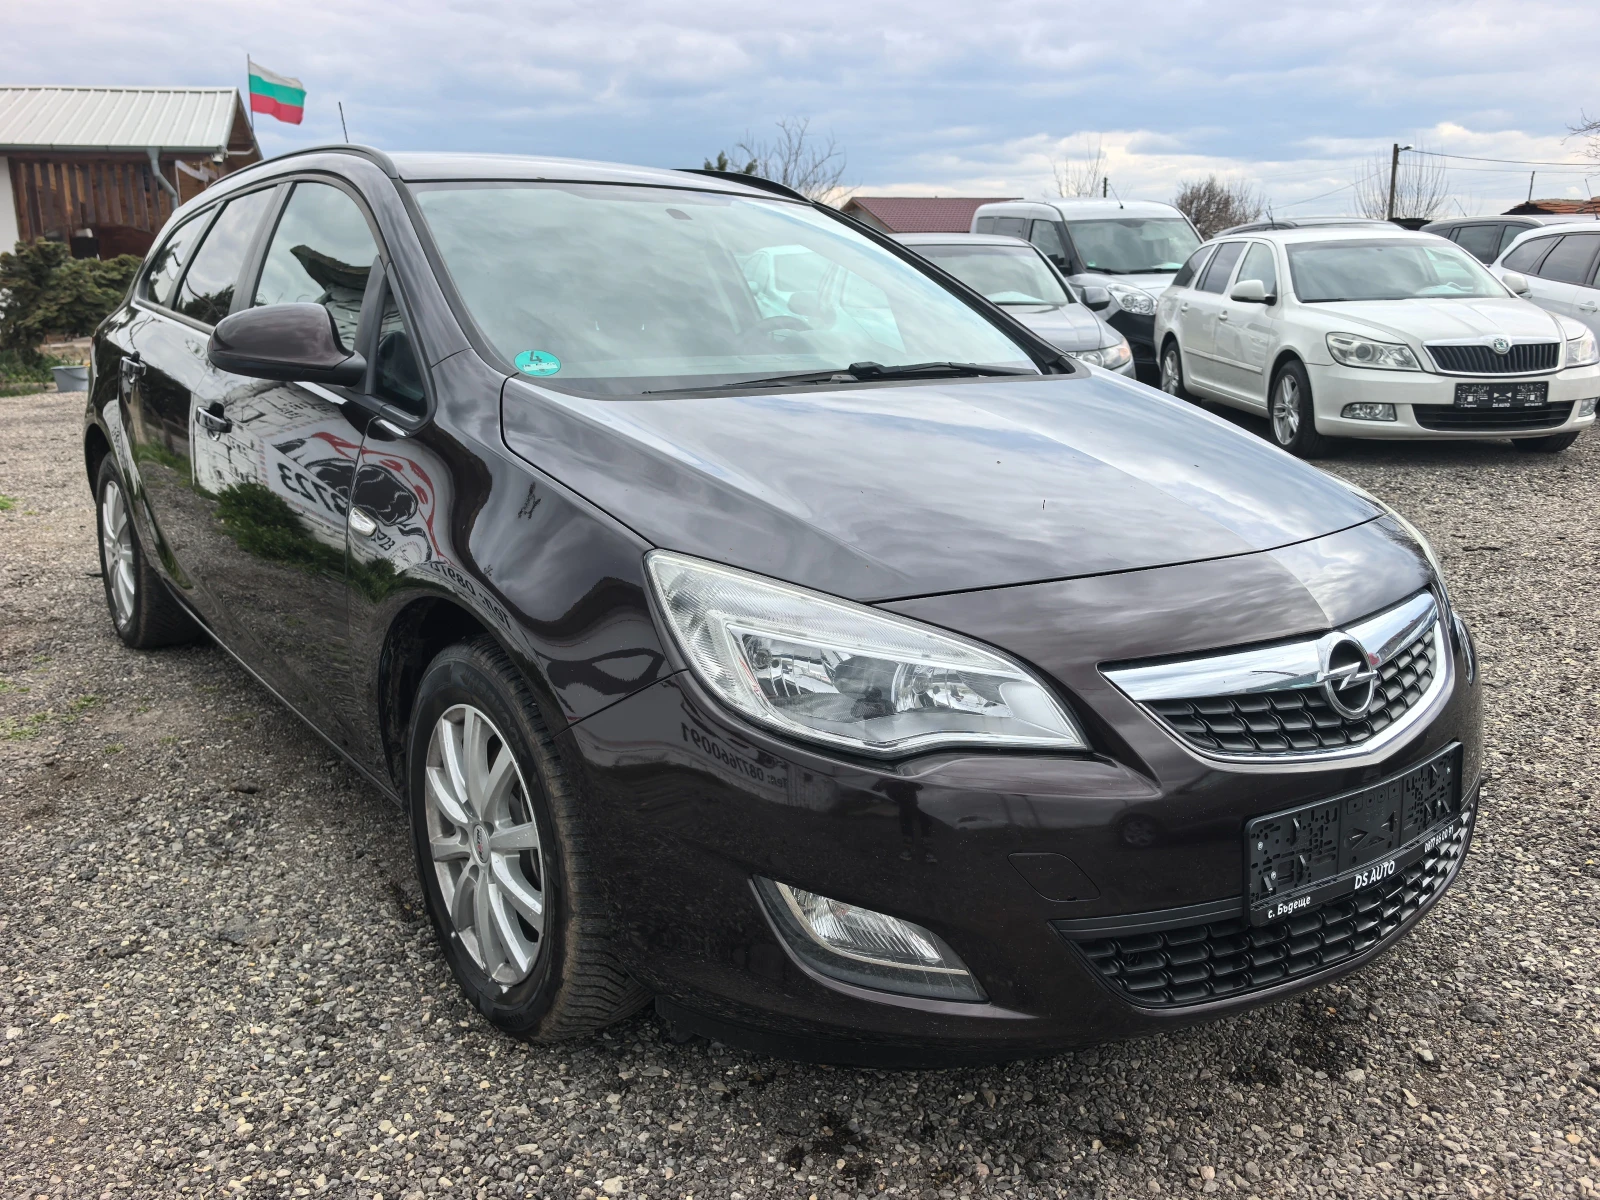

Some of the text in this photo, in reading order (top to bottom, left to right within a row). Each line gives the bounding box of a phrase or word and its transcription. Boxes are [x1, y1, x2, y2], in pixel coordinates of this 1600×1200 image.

[529, 350, 542, 362] 4
[1354, 860, 1395, 890] DS AUTO
[1277, 896, 1311, 915] Бъдеще
